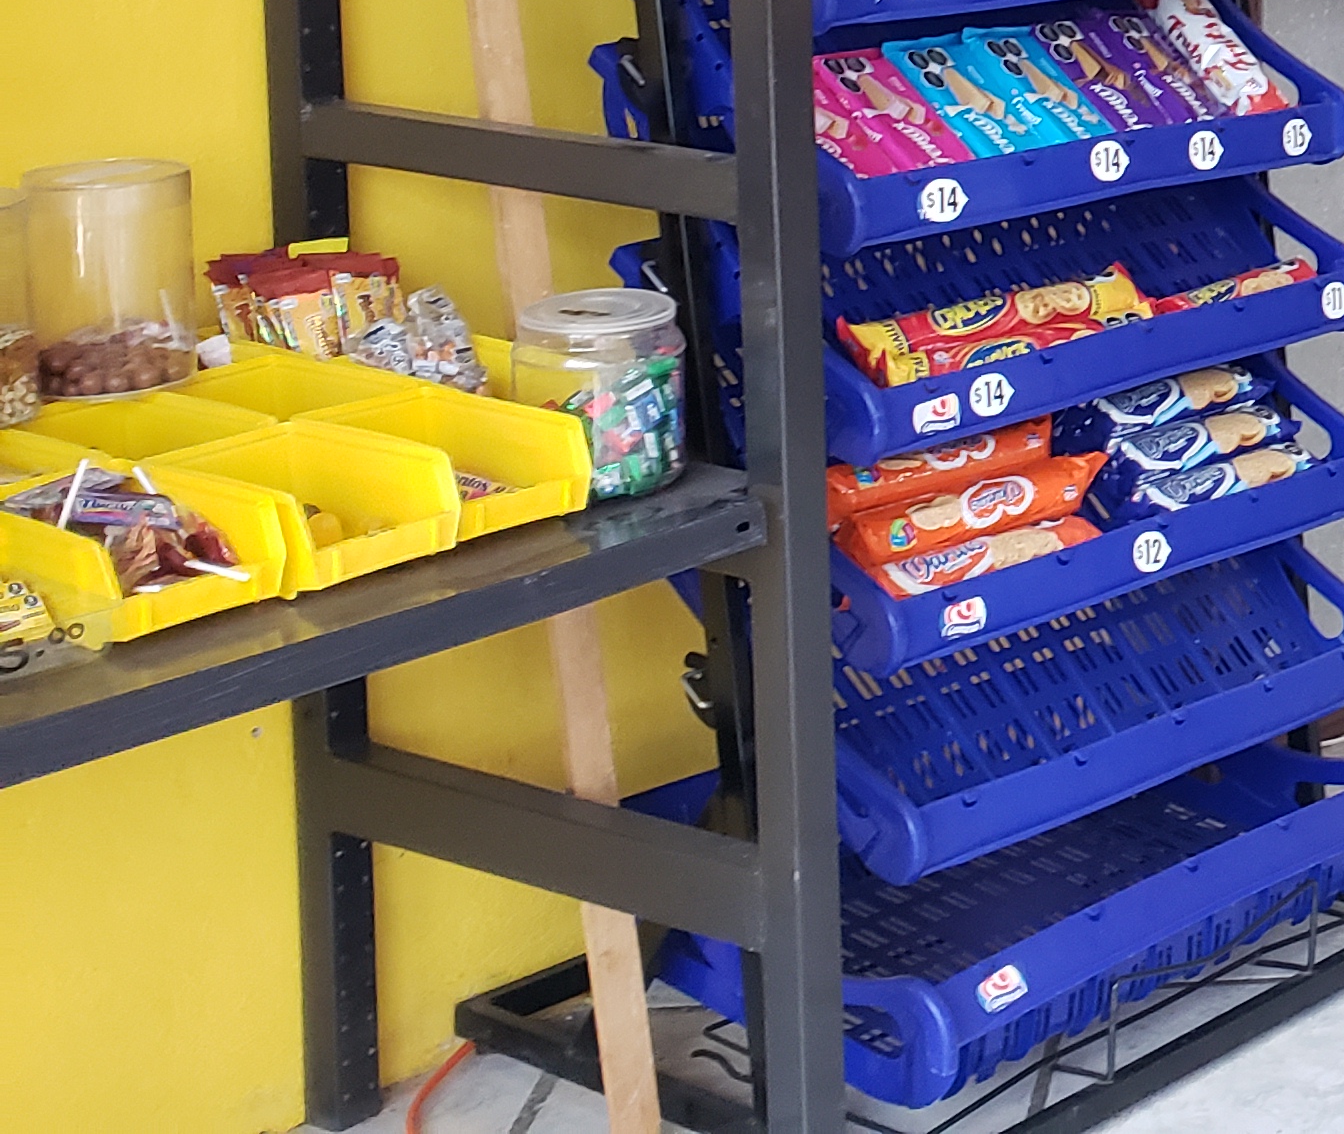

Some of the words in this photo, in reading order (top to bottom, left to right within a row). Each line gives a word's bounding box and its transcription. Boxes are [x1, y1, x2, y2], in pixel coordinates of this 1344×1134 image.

[1192, 136, 1216, 162] $14
[1286, 124, 1306, 149] $15
[1094, 147, 1121, 173] $14
[927, 187, 959, 214] $14
[974, 379, 1005, 407] $14
[1137, 538, 1162, 565] $12
